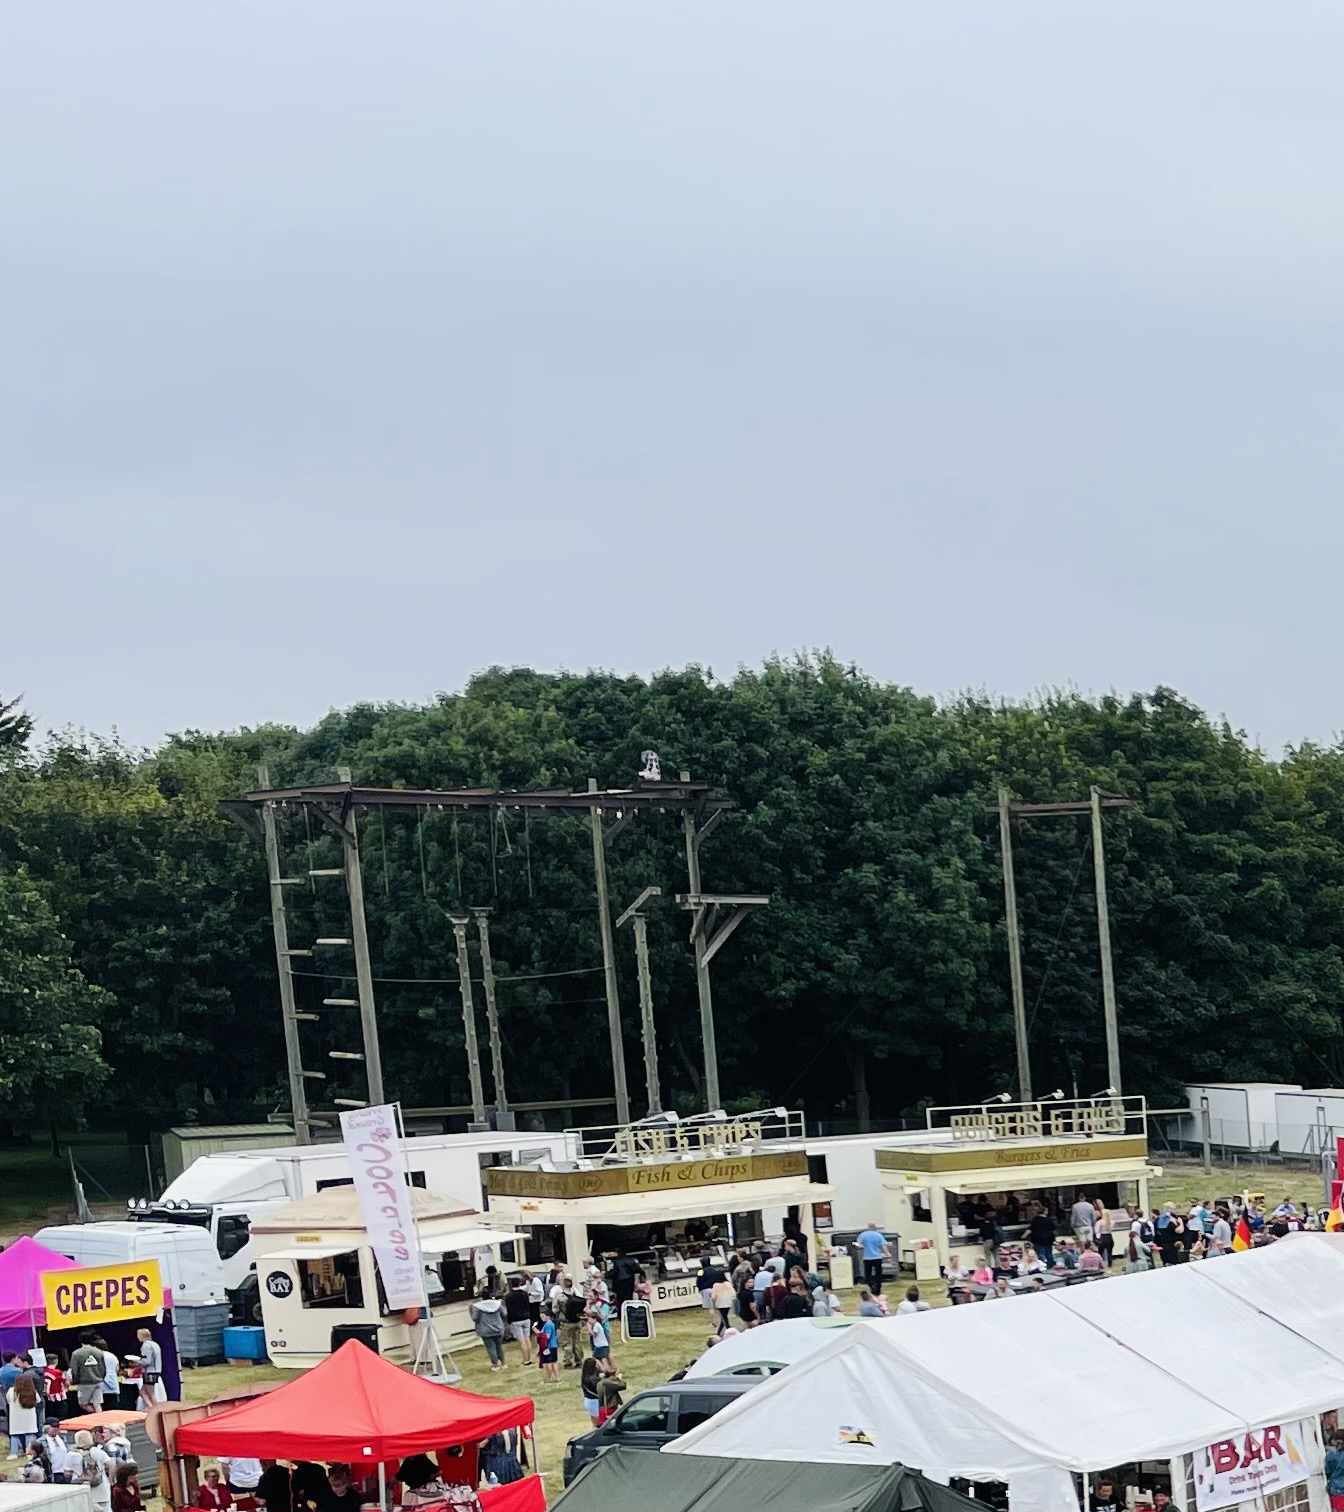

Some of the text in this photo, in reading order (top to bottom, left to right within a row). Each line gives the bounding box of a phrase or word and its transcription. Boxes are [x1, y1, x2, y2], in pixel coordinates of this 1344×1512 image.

[615, 1131, 666, 1158] FISH
[699, 1122, 761, 1151] CHIPS
[950, 1111, 1043, 1140] BURGERS
[633, 1164, 670, 1184] Fish
[701, 1161, 749, 1180] Chips
[56, 1274, 151, 1316] CREPES
[1211, 1425, 1286, 1474] BAR
